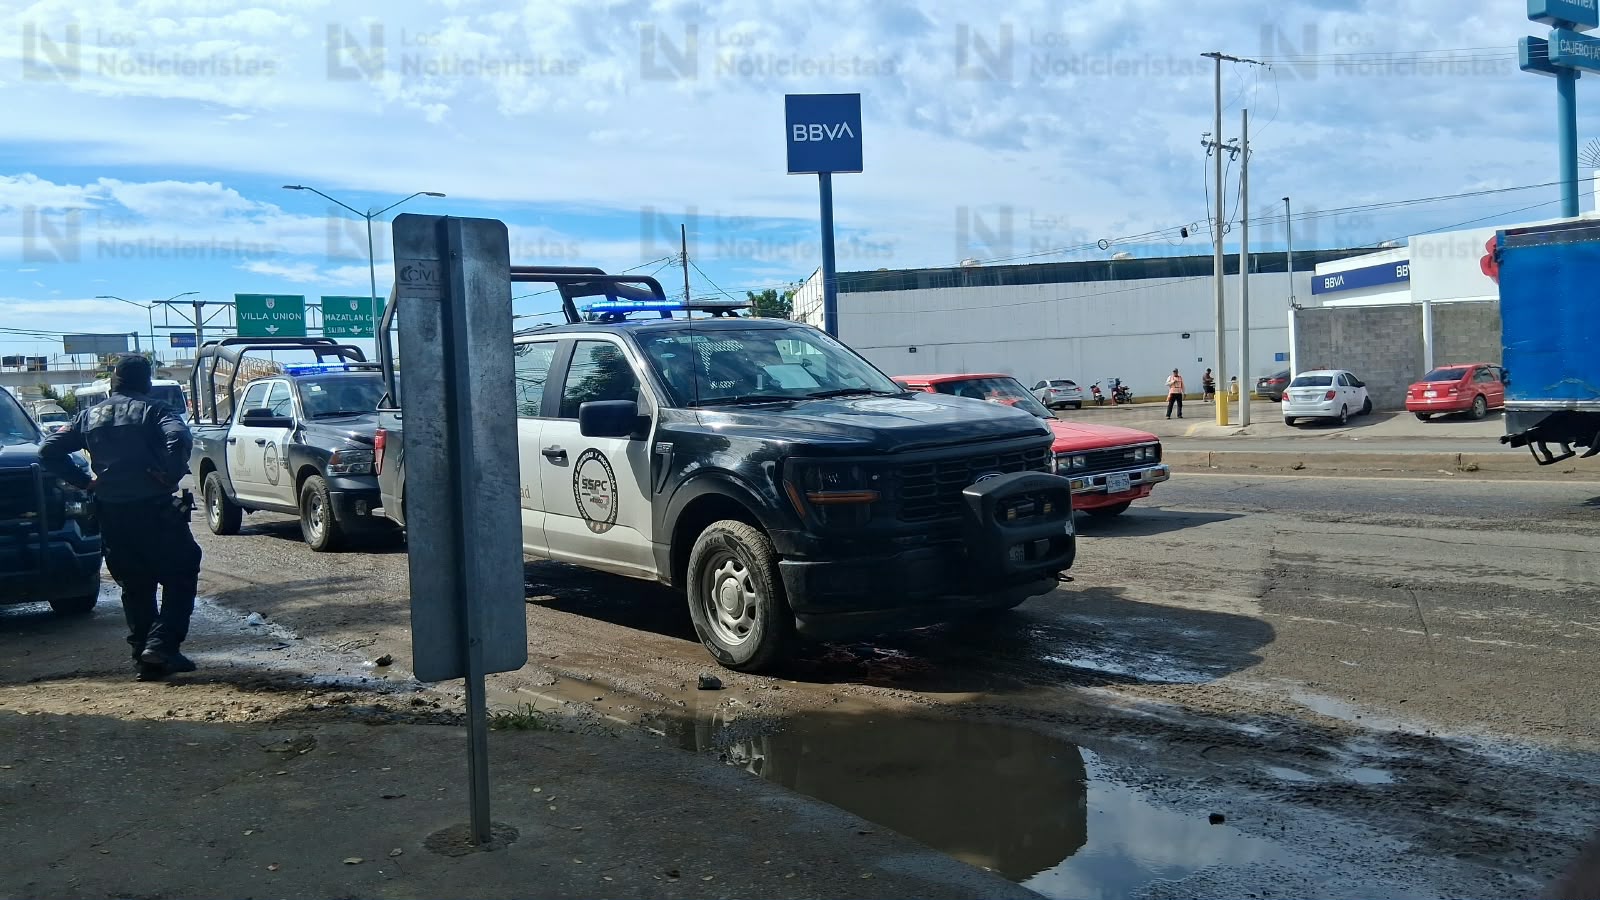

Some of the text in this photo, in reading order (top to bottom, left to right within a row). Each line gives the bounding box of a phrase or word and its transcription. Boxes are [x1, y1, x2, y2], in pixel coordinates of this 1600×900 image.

[793, 122, 854, 141] BBVA
[1324, 275, 1344, 288] BBVA
[241, 312, 302, 320] VILLA UNION
[325, 313, 364, 321] MAZATLAN
[581, 478, 608, 491] SSPC
